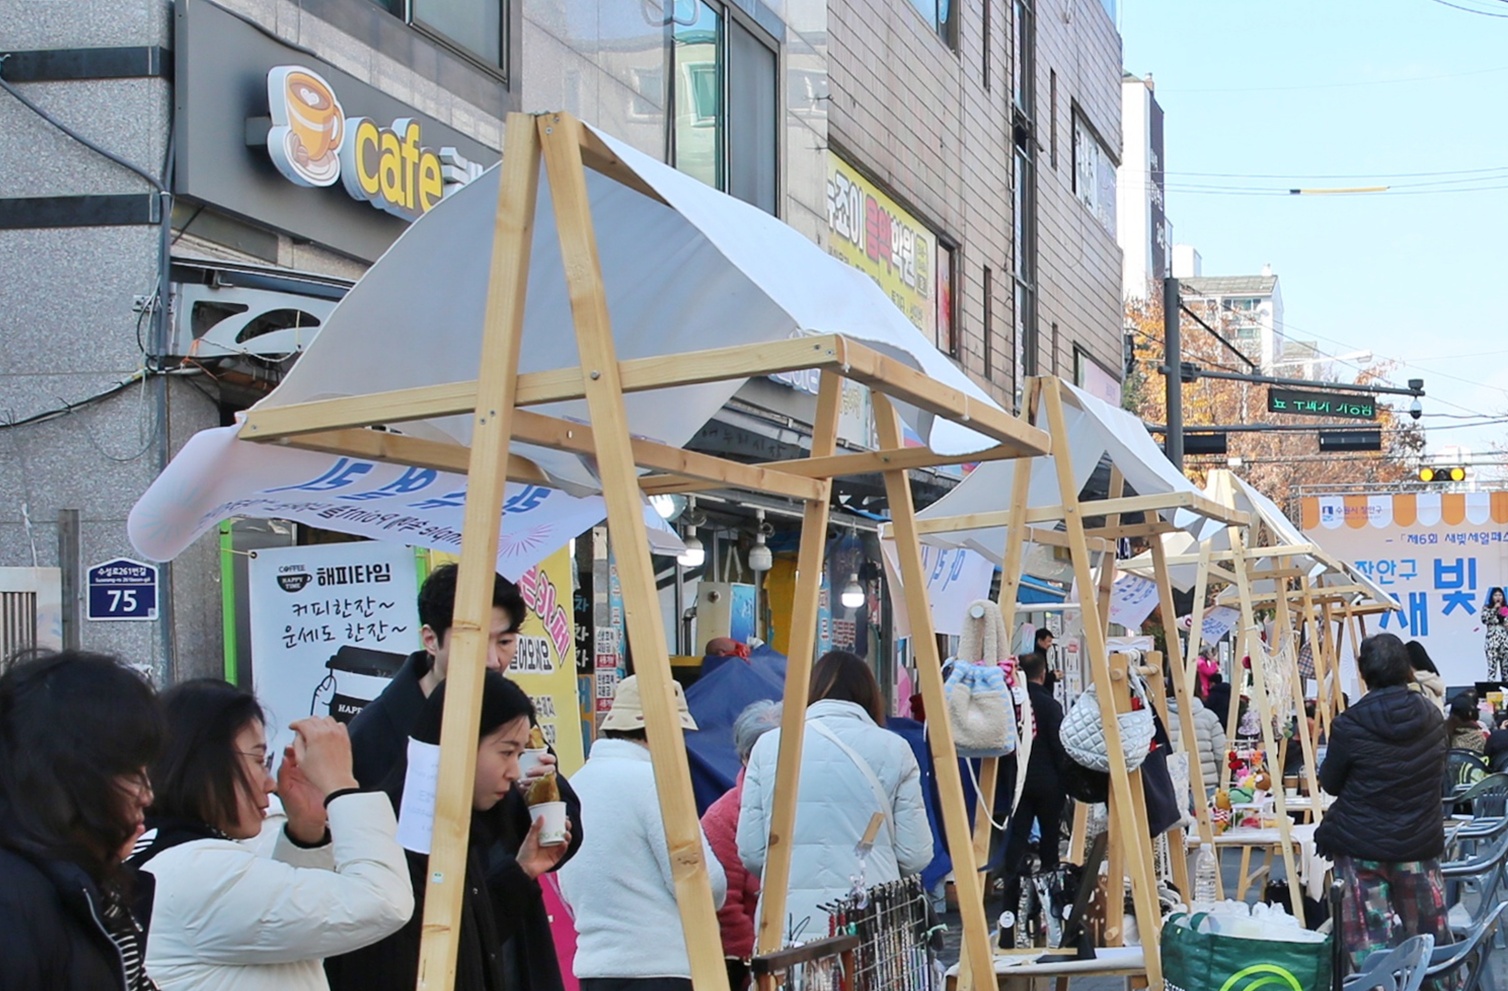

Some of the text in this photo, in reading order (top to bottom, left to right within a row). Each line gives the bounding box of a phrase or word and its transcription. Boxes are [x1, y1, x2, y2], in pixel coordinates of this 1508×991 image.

[356, 121, 442, 212] cafe
[279, 564, 306, 573] COFFEE
[281, 576, 304, 584] HAPPY
[316, 563, 391, 586] 해피타임
[1354, 559, 1418, 585] 장안구
[107, 589, 137, 612] 75
[282, 620, 408, 649] 운세도 한잔~
[338, 703, 364, 714] HAPP
